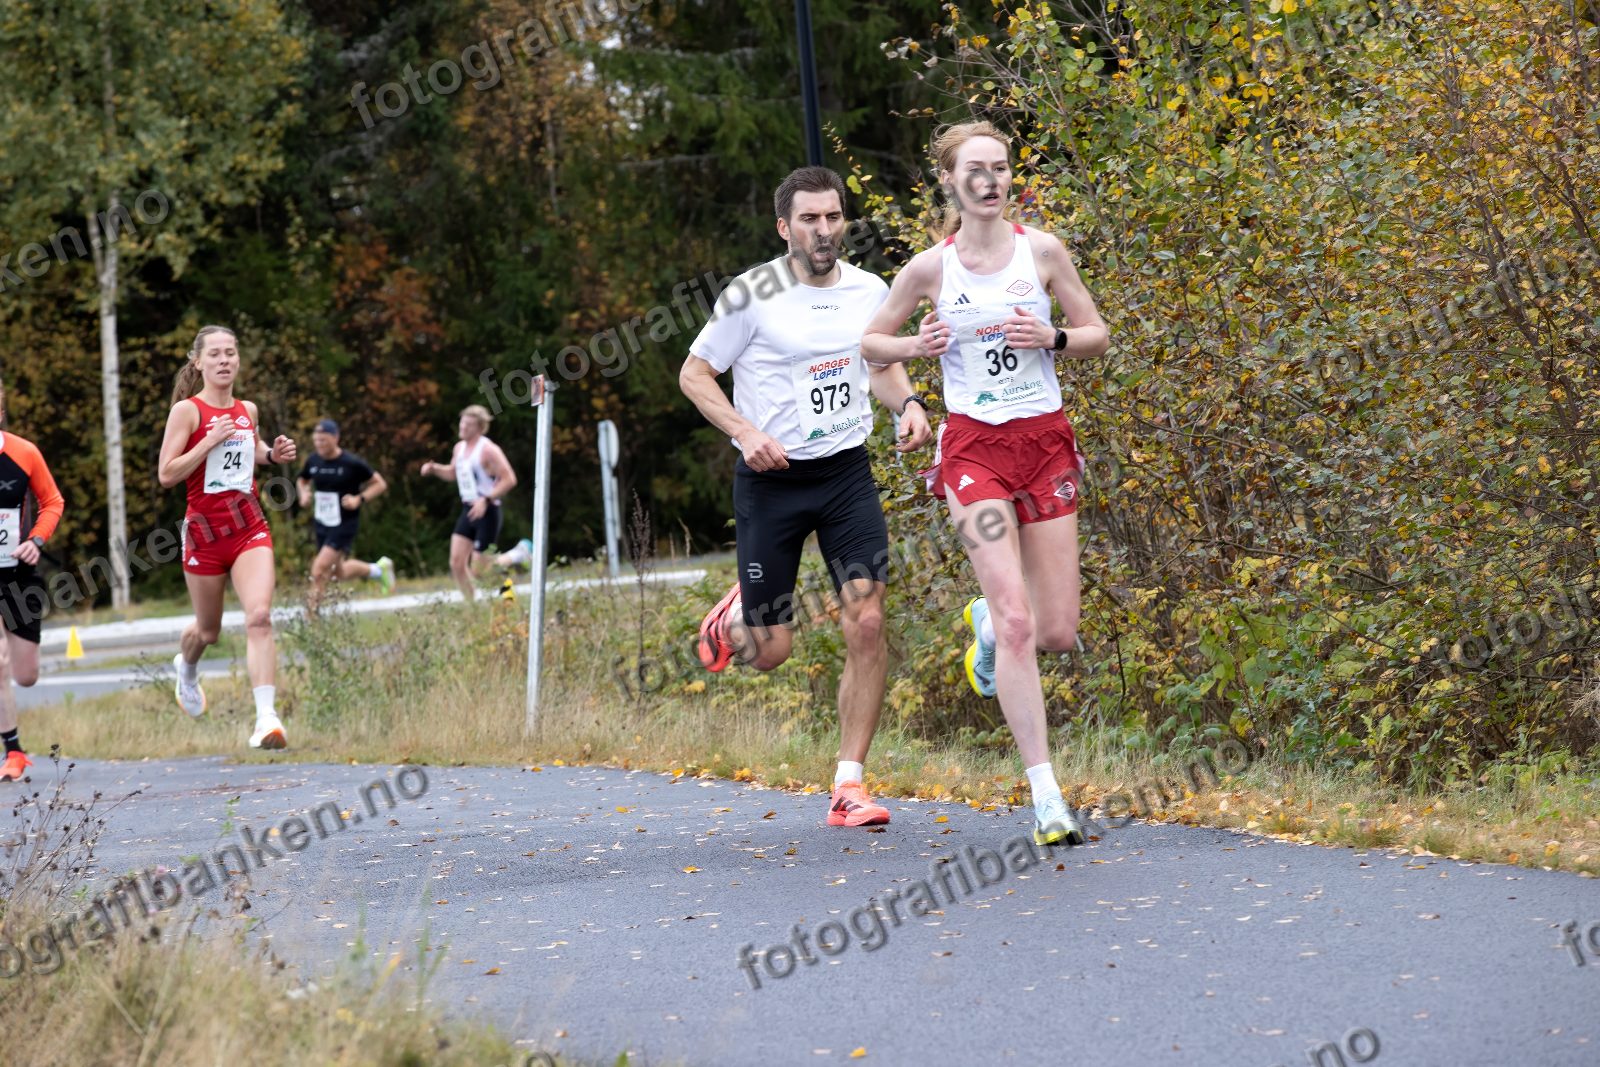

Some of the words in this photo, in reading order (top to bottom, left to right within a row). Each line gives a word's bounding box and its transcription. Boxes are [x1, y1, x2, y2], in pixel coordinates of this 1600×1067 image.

[809, 357, 851, 374] NORGES
[985, 344, 1018, 376] 36
[813, 366, 844, 381] LØPET
[810, 381, 851, 415] 973
[223, 451, 242, 470] 24
